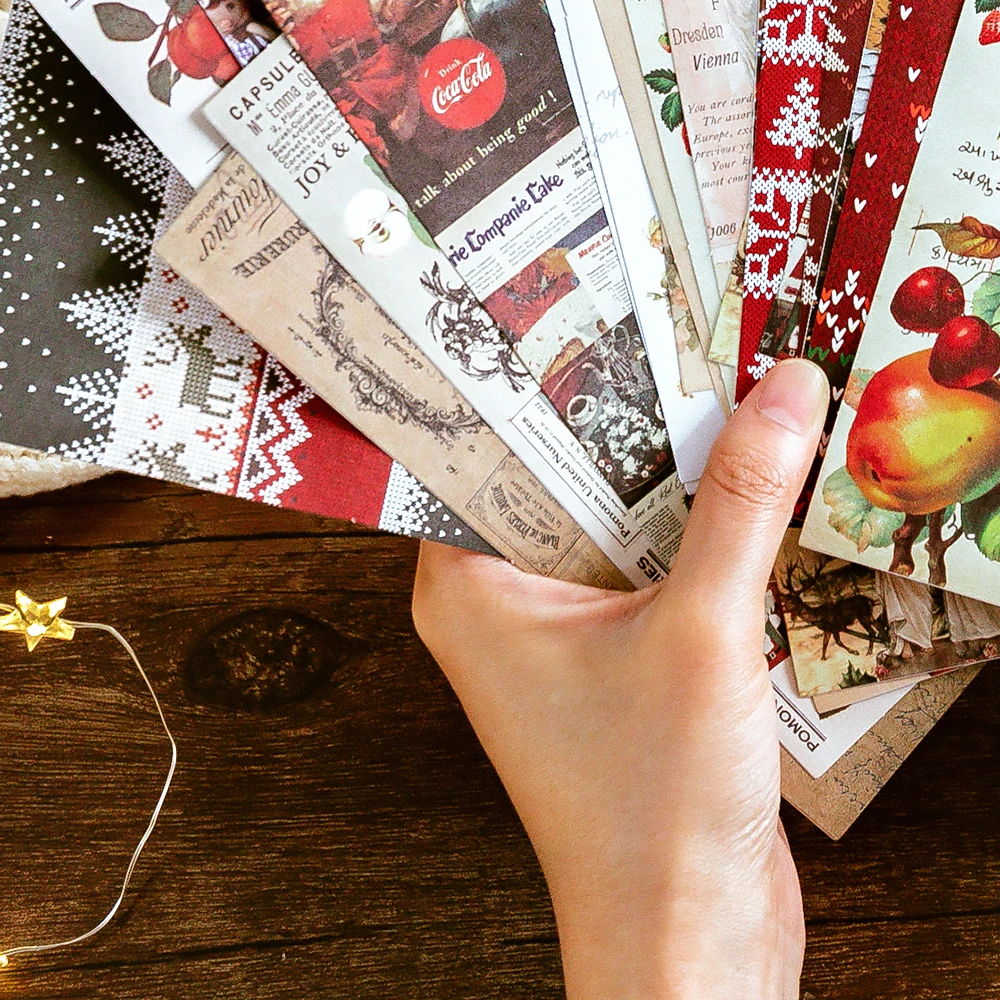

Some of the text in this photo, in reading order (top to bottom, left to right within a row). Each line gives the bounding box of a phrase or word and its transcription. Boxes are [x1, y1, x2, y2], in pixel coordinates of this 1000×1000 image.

[671, 23, 724, 46] Dresden
[438, 58, 462, 78] Drink
[693, 50, 739, 72] Vienna
[686, 101, 706, 114] You
[709, 98, 728, 109] are
[701, 114, 722, 126] The
[691, 127, 733, 147] Europe,
[415, 182, 441, 209] talk
[443, 155, 477, 188] about
[476, 126, 516, 158] being
[516, 96, 547, 134] good
[692, 142, 736, 162] previous
[292, 163, 334, 199] JOY
[331, 138, 350, 158] &
[711, 157, 737, 172] Your
[700, 176, 725, 189] most
[464, 196, 532, 255] Companie
[525, 173, 564, 203] Cake
[518, 414, 564, 464] Nurseries
[558, 459, 594, 497] United
[589, 493, 632, 539] Pomona
